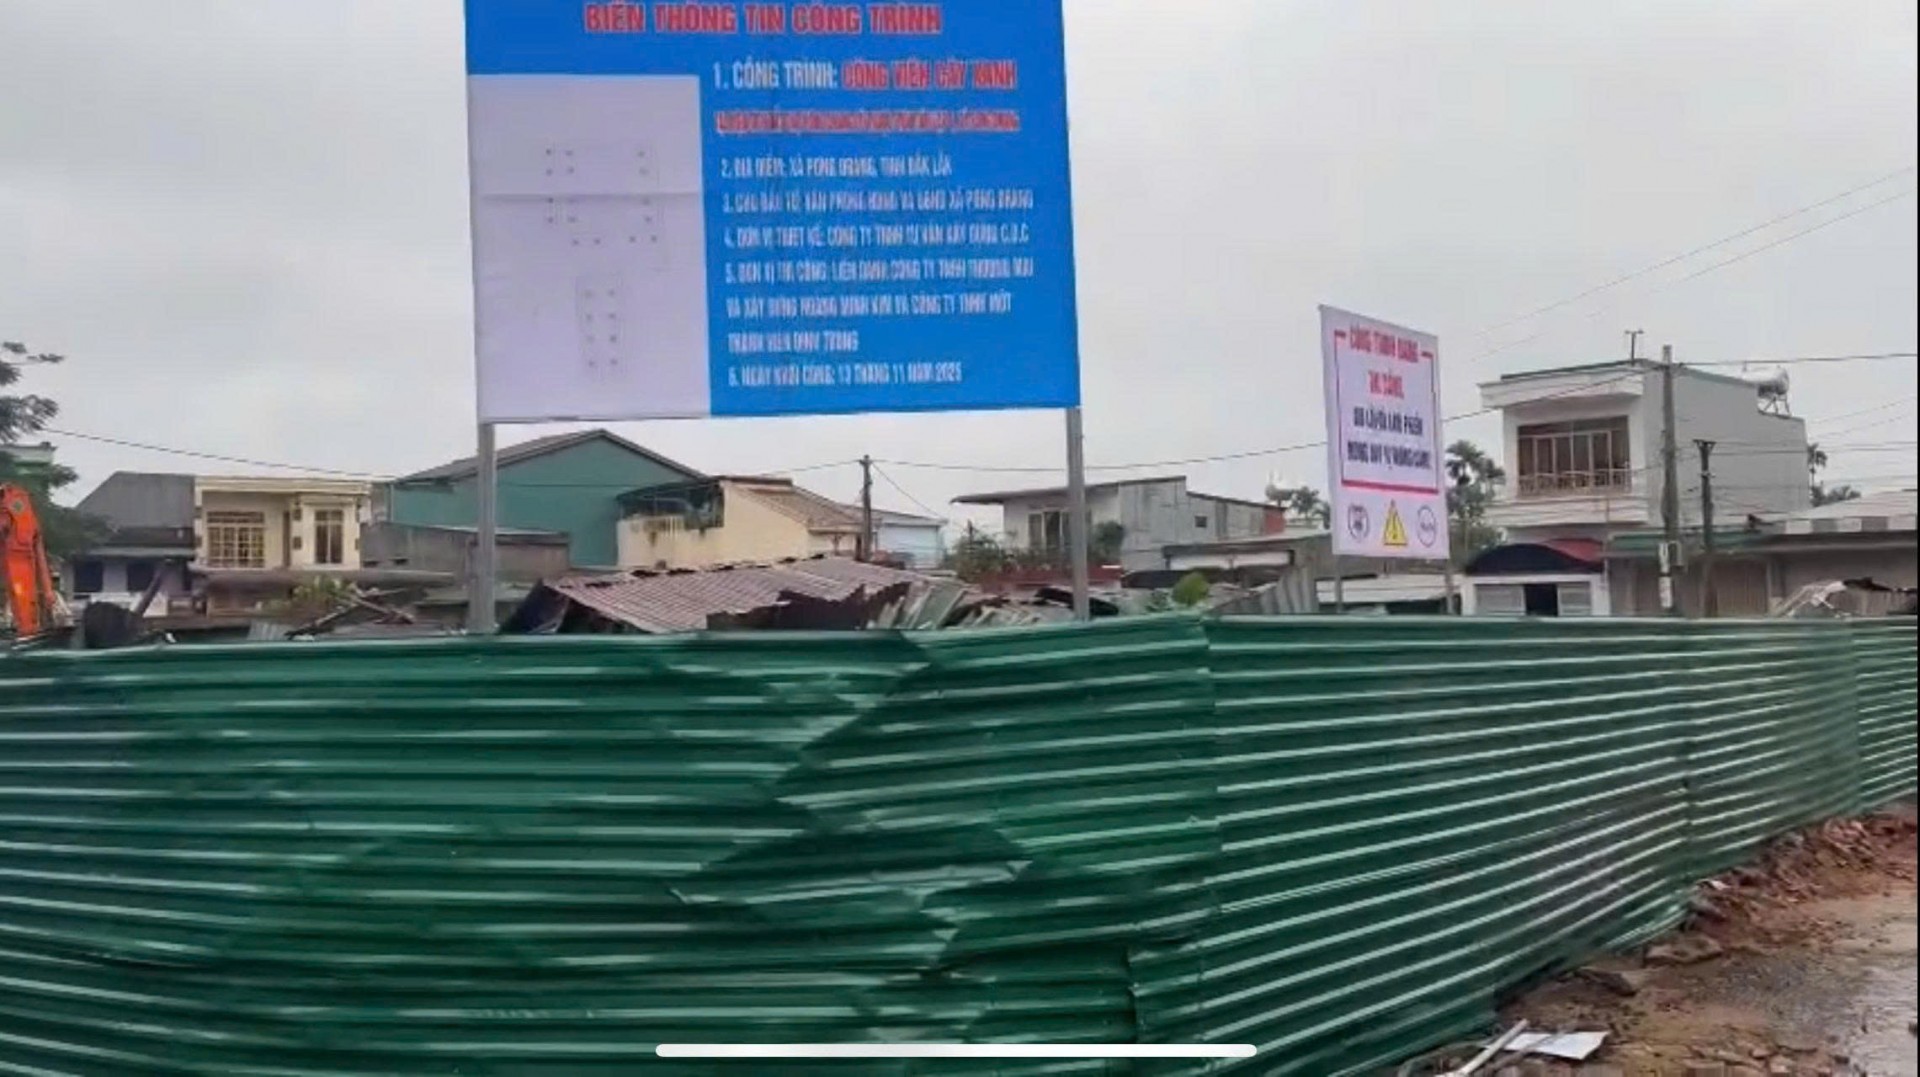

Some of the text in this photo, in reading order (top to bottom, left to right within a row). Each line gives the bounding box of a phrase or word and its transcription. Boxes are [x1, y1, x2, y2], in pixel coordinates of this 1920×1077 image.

[744, 3, 785, 33] TIN
[792, 0, 862, 34] CÔNG
[713, 62, 728, 89] 1.
[733, 56, 779, 89] CÔNG
